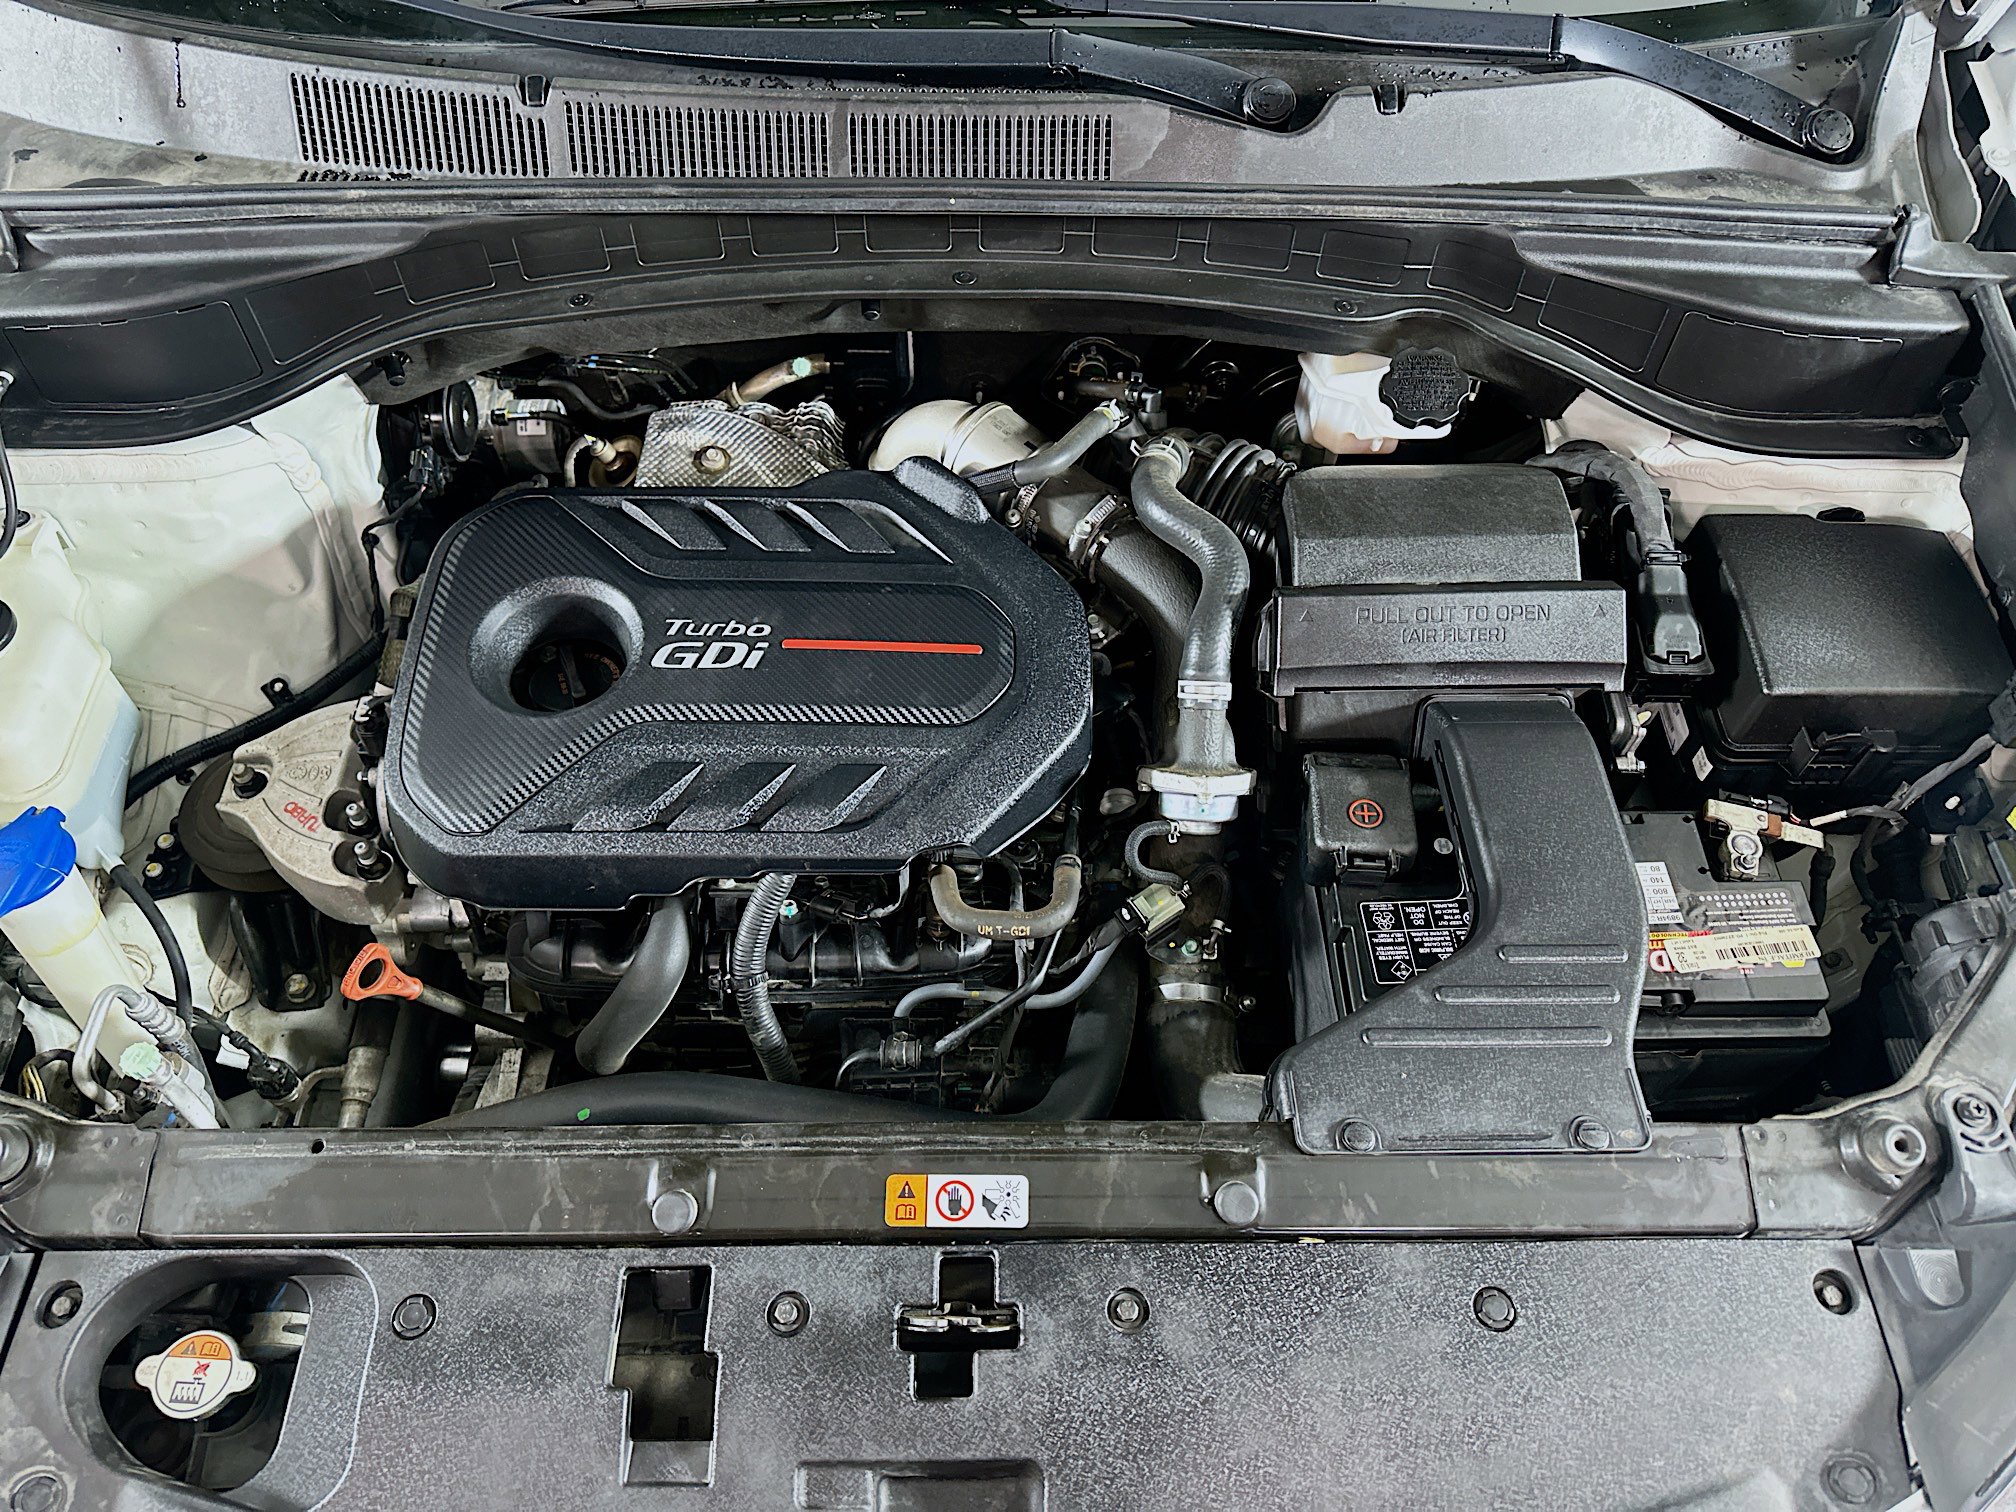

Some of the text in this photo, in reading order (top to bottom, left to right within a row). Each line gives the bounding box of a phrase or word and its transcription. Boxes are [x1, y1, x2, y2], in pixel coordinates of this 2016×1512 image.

[1356, 604, 1550, 624] PULL OUT TO OPEN
[665, 618, 772, 637] Turbo
[1401, 626, 1506, 644] (AIR FILTER)
[650, 641, 770, 670] GDi
[284, 802, 322, 832] TURBO
[996, 925, 1031, 936] T-GDI
[1676, 952, 1688, 963] 32
